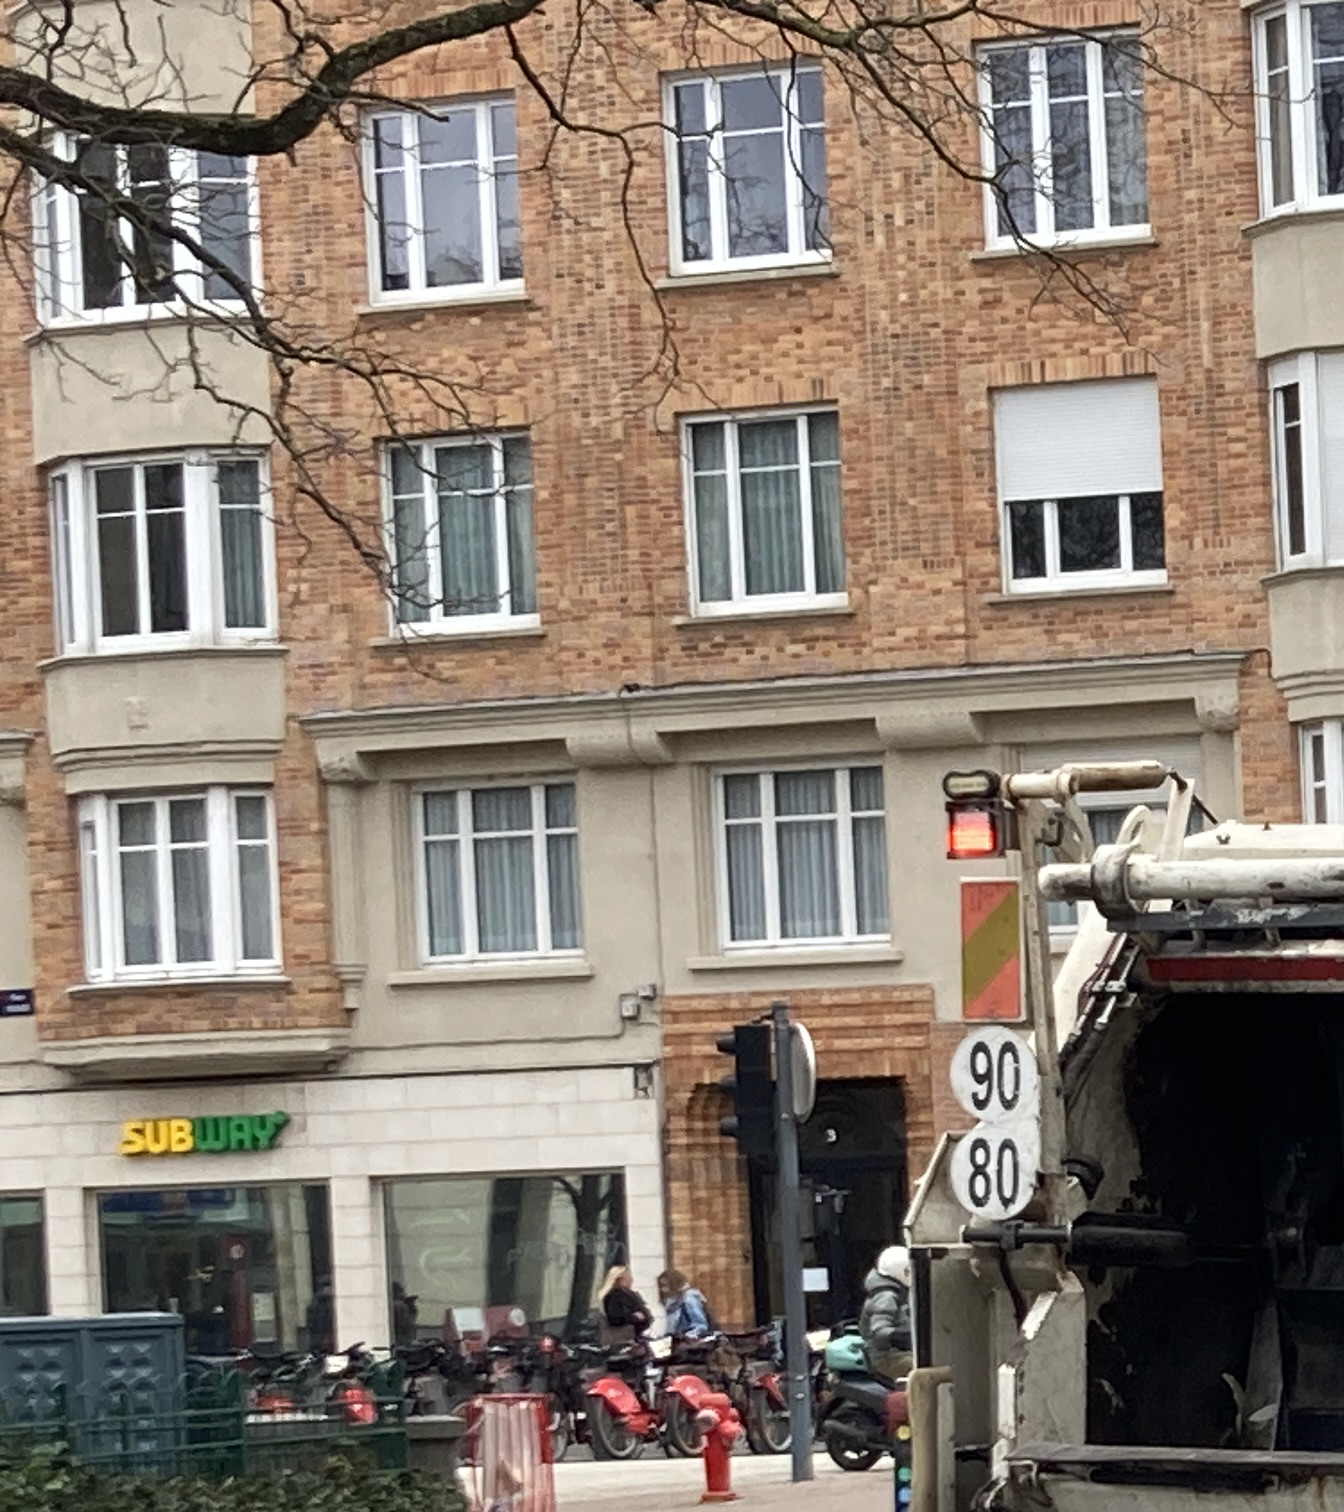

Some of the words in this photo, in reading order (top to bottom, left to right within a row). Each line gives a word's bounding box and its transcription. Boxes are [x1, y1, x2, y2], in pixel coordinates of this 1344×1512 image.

[969, 1041, 1021, 1111] 90
[118, 1110, 291, 1155] SUBWAY
[968, 1137, 1020, 1209] 80
